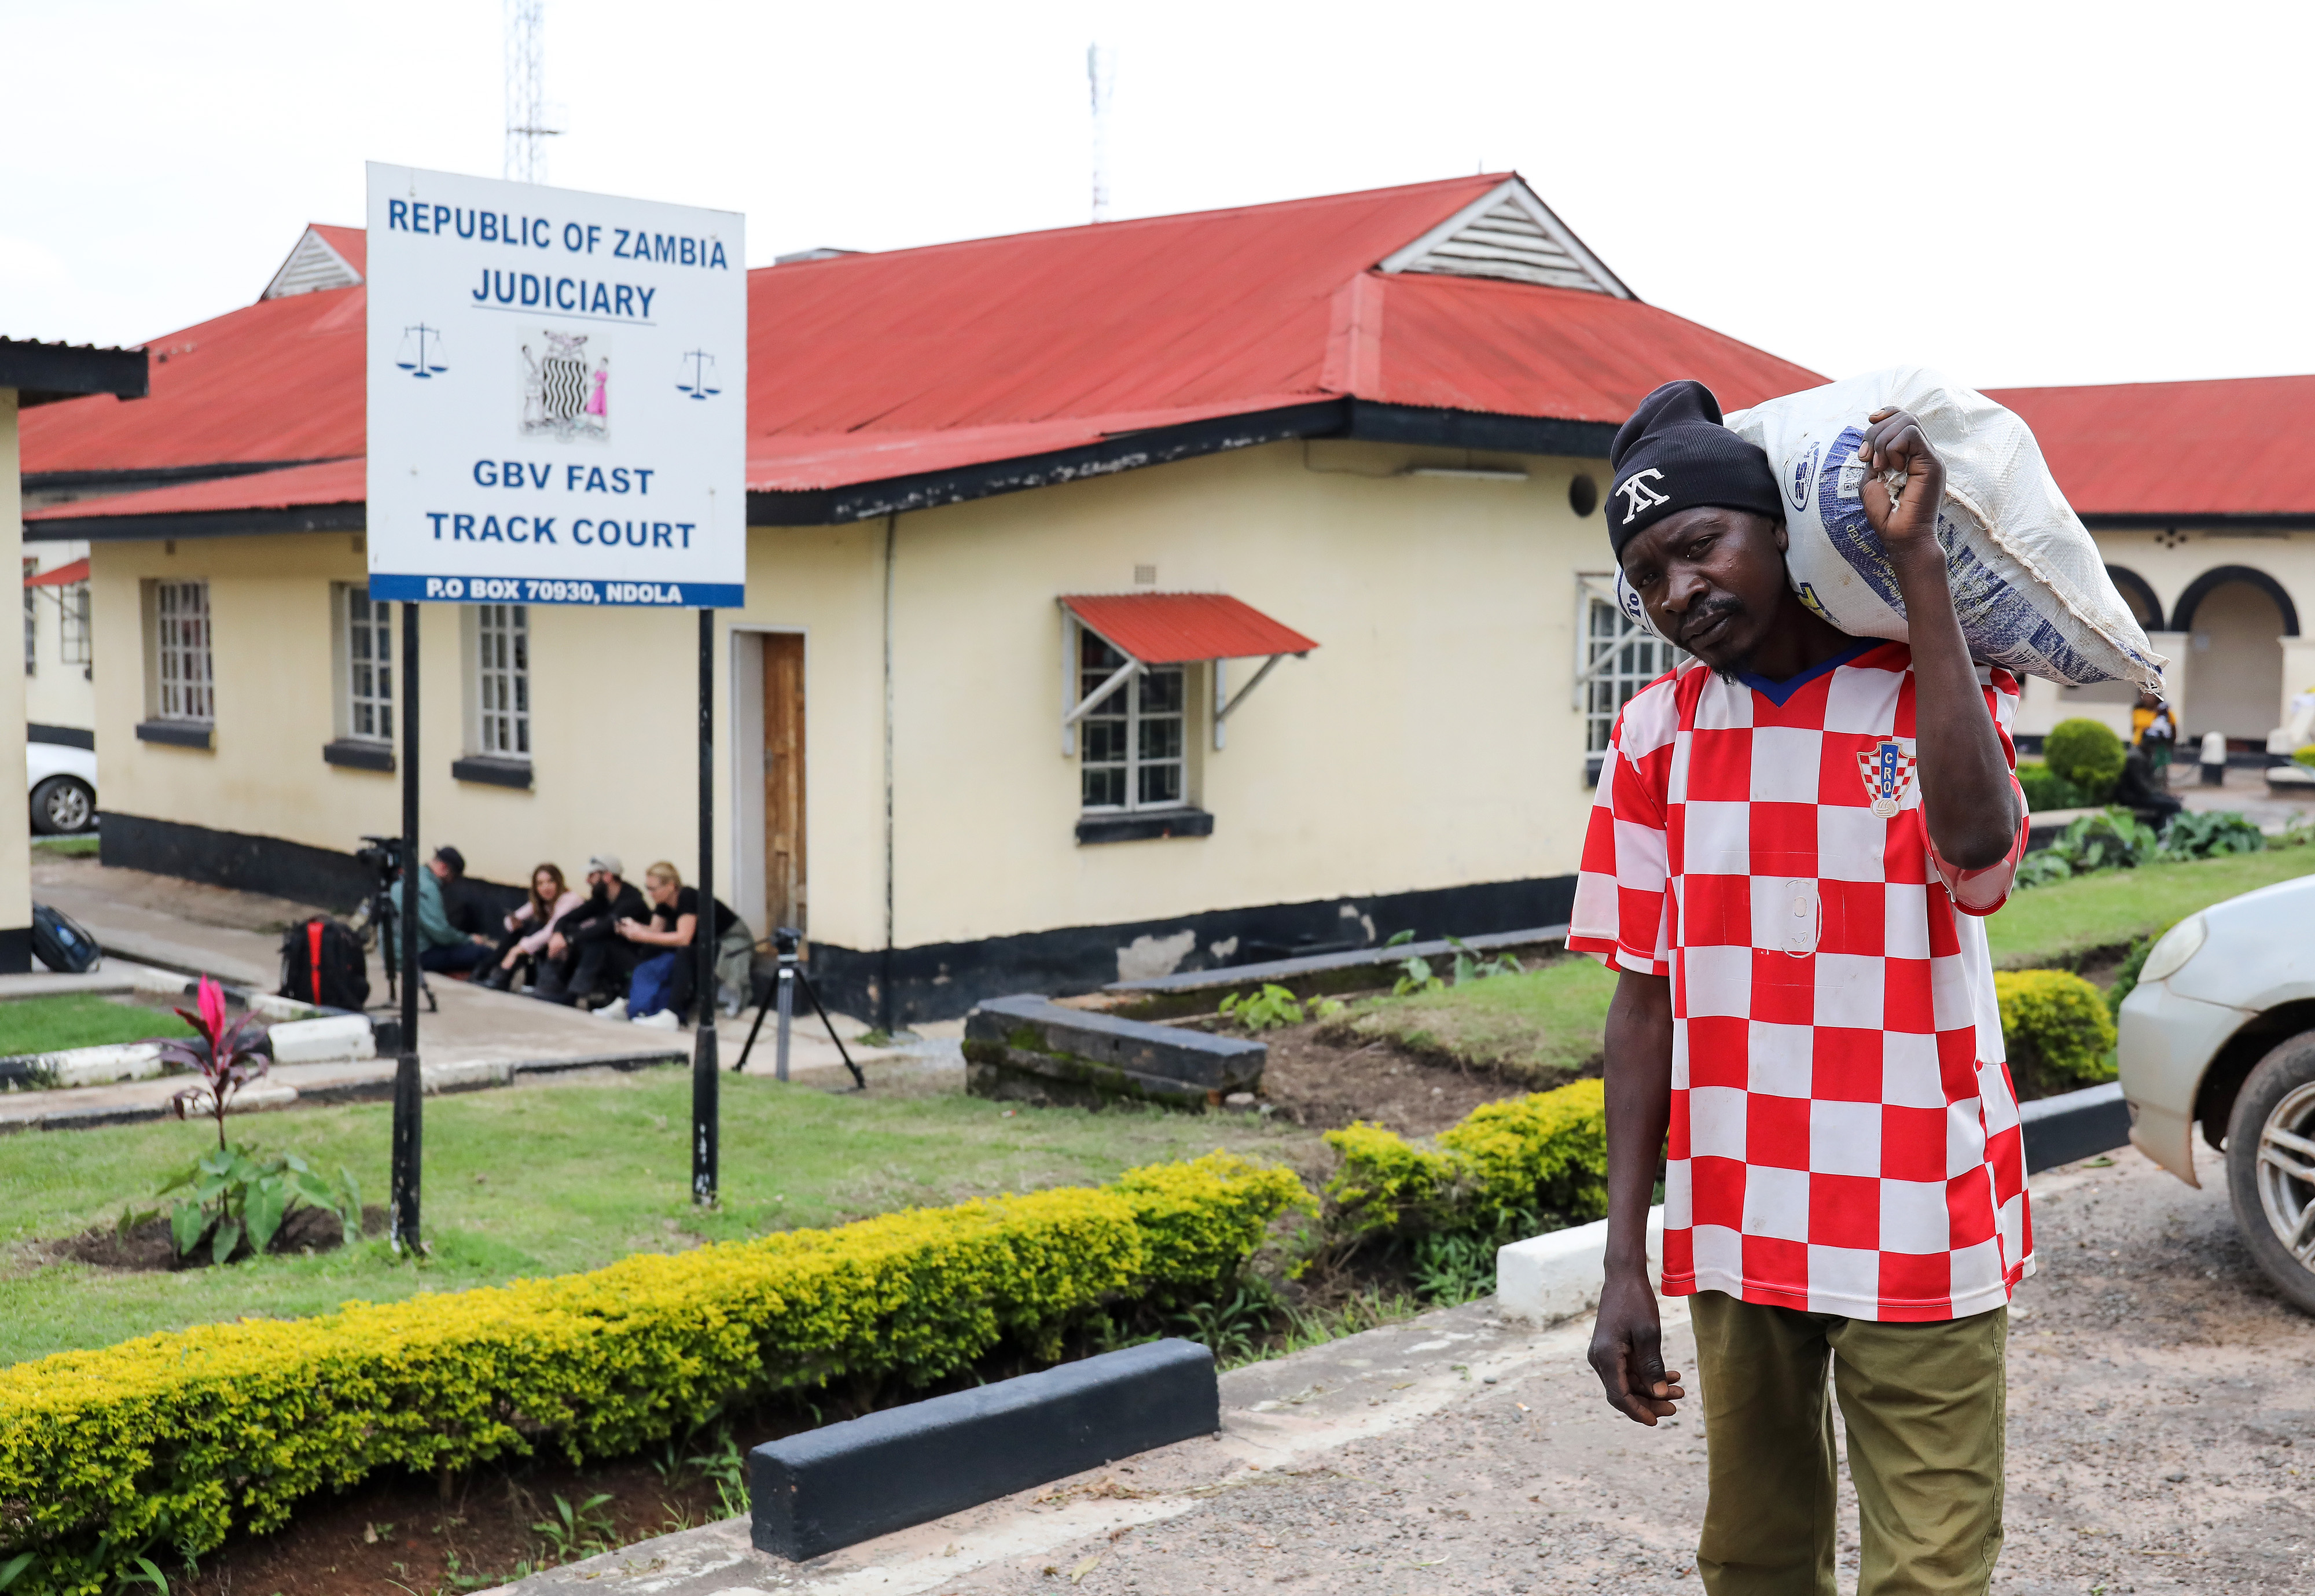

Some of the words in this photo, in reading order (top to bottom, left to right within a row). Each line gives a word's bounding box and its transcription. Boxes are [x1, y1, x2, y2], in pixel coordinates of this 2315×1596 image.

[389, 199, 550, 249] REPUBLIC
[563, 222, 601, 254] OF
[613, 229, 728, 269] ZAMBIA
[472, 269, 656, 318] JUDICIARY
[473, 459, 552, 490] GBV
[567, 465, 655, 495] FAST
[1795, 462, 1807, 500] 25
[427, 512, 557, 545] TRACK
[572, 518, 696, 549] COURT
[1845, 524, 1877, 557] LIMITED
[427, 579, 464, 597] P.O
[471, 580, 519, 598] BOX
[527, 582, 600, 604] 70930,
[607, 584, 682, 602] NDOLA
[1626, 593, 1641, 618] To
[1883, 752, 1893, 793] CRO
